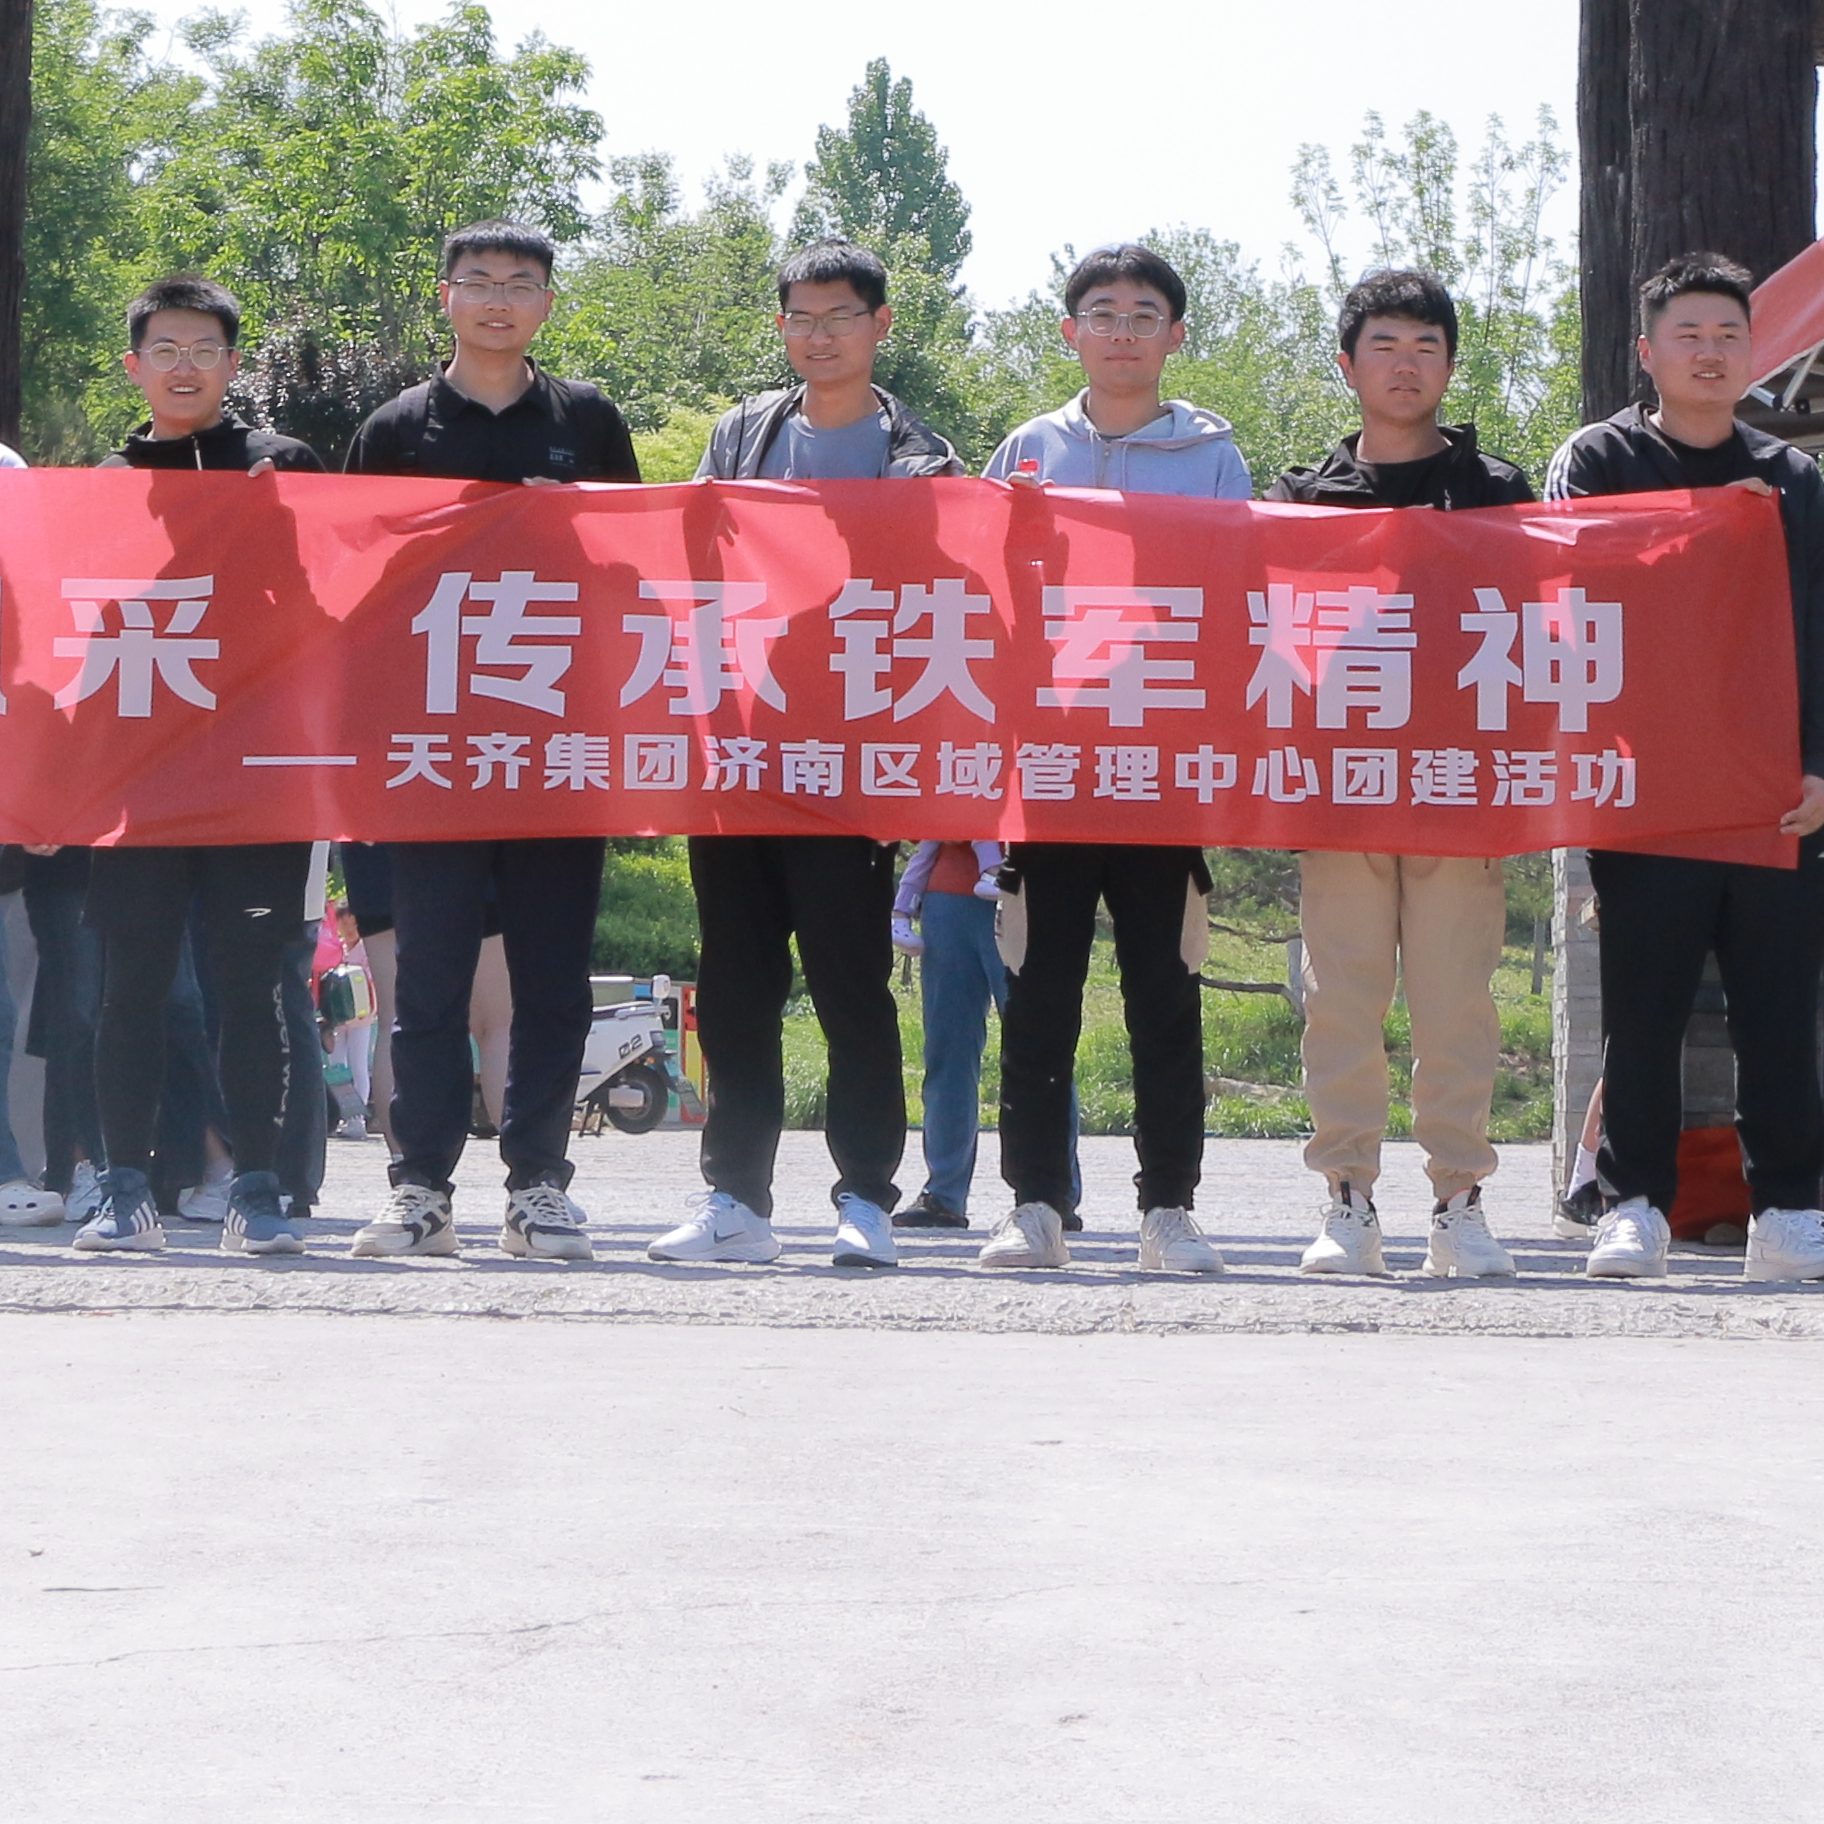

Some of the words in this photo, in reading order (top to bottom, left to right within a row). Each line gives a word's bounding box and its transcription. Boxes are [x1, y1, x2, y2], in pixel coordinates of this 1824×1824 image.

[411, 570, 1626, 732] 传承铁军精神
